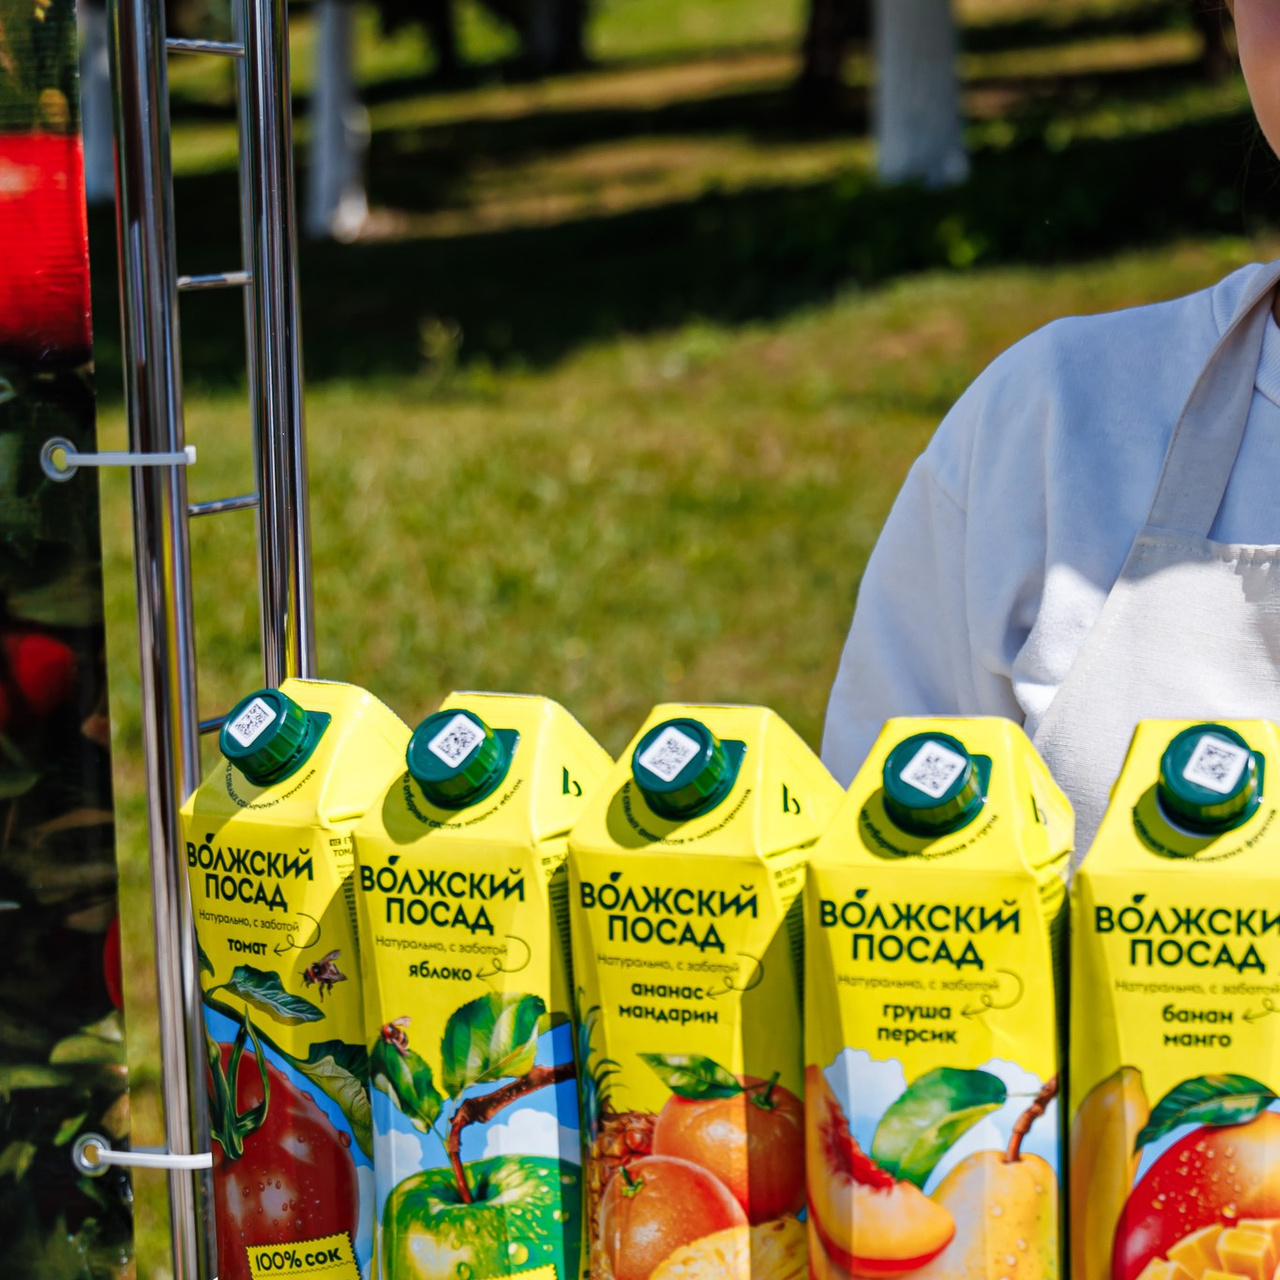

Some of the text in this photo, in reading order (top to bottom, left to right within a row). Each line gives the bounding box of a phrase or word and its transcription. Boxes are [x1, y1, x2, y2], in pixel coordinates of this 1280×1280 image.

[186, 834, 314, 881] ВОЛЖСКИЙ
[360, 856, 525, 902] ВОЛЖСКИЙ
[205, 874, 288, 912] ПОСАД
[580, 872, 758, 918] ВОЛЖСКИЙ
[199, 909, 300, 932] Натурально, с заботой
[386, 897, 495, 936] ПОСАД
[820, 889, 1020, 933] ВОЛЖСКИЙ
[376, 935, 508, 956] Натурально, с заботой
[608, 915, 725, 953] ПОСАД
[227, 938, 268, 956] томат
[852, 933, 984, 970] ПОСАД
[1130, 939, 1266, 974] ПОСАД
[409, 961, 472, 981] яблоко
[597, 954, 740, 973] Натурально, с заботой
[631, 982, 704, 1000] ананас
[619, 1004, 719, 1025] мандарин
[883, 1004, 951, 1021] груша
[1162, 1005, 1233, 1024] банан
[877, 1027, 957, 1044] персик
[1163, 1032, 1231, 1047] манго
[255, 1248, 342, 1271] 100% сок
